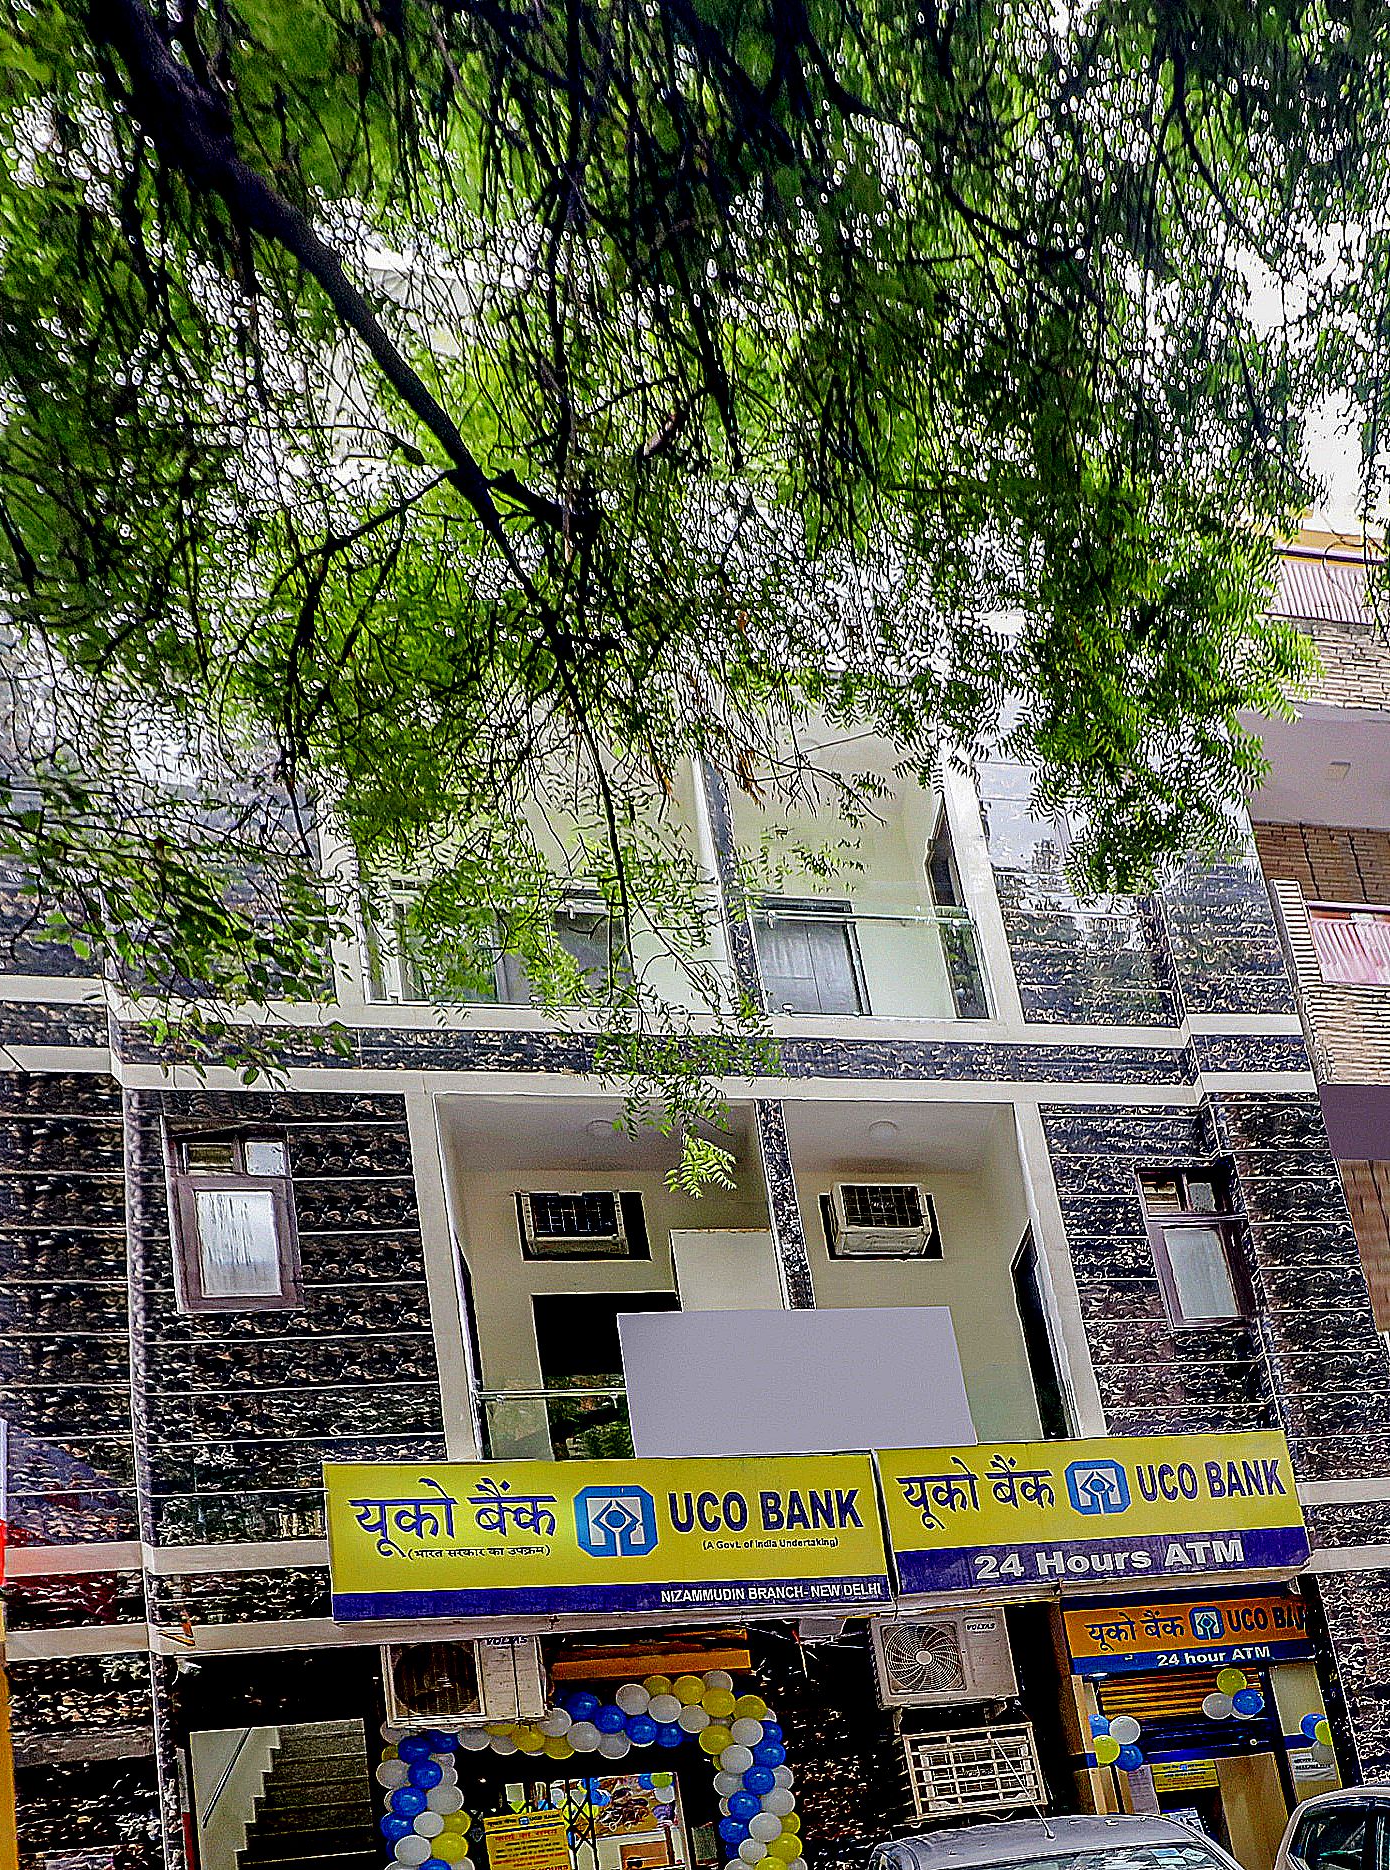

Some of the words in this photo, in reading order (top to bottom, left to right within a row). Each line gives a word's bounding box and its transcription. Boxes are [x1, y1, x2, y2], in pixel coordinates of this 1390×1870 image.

[895, 1456, 980, 1530] यूको
[985, 1455, 1057, 1509] बैंक
[1135, 1462, 1197, 1503] UCO
[1203, 1459, 1287, 1501] BANK
[347, 1477, 460, 1557] यूको
[468, 1477, 557, 1538] बैंक
[667, 1491, 748, 1533] UCO
[760, 1488, 864, 1531] BANK
[487, 1547, 505, 1556] का
[743, 1539, 753, 1548] of
[755, 1539, 778, 1548] India
[779, 1537, 839, 1548] Undertaking)
[974, 1553, 1024, 1580] 24
[1035, 1549, 1153, 1577] Hours
[1163, 1540, 1245, 1567] ATM
[661, 1587, 745, 1603] NIZAMMUDIN
[810, 1584, 841, 1598] NEW
[843, 1583, 882, 1596] DELHI
[1085, 1612, 1138, 1651] यूको
[1140, 1610, 1185, 1639] बैंक
[1227, 1608, 1269, 1634] UCO
[1157, 1654, 1180, 1667] 24
[1183, 1651, 1226, 1666] hour
[1232, 1646, 1271, 1662] ATM
